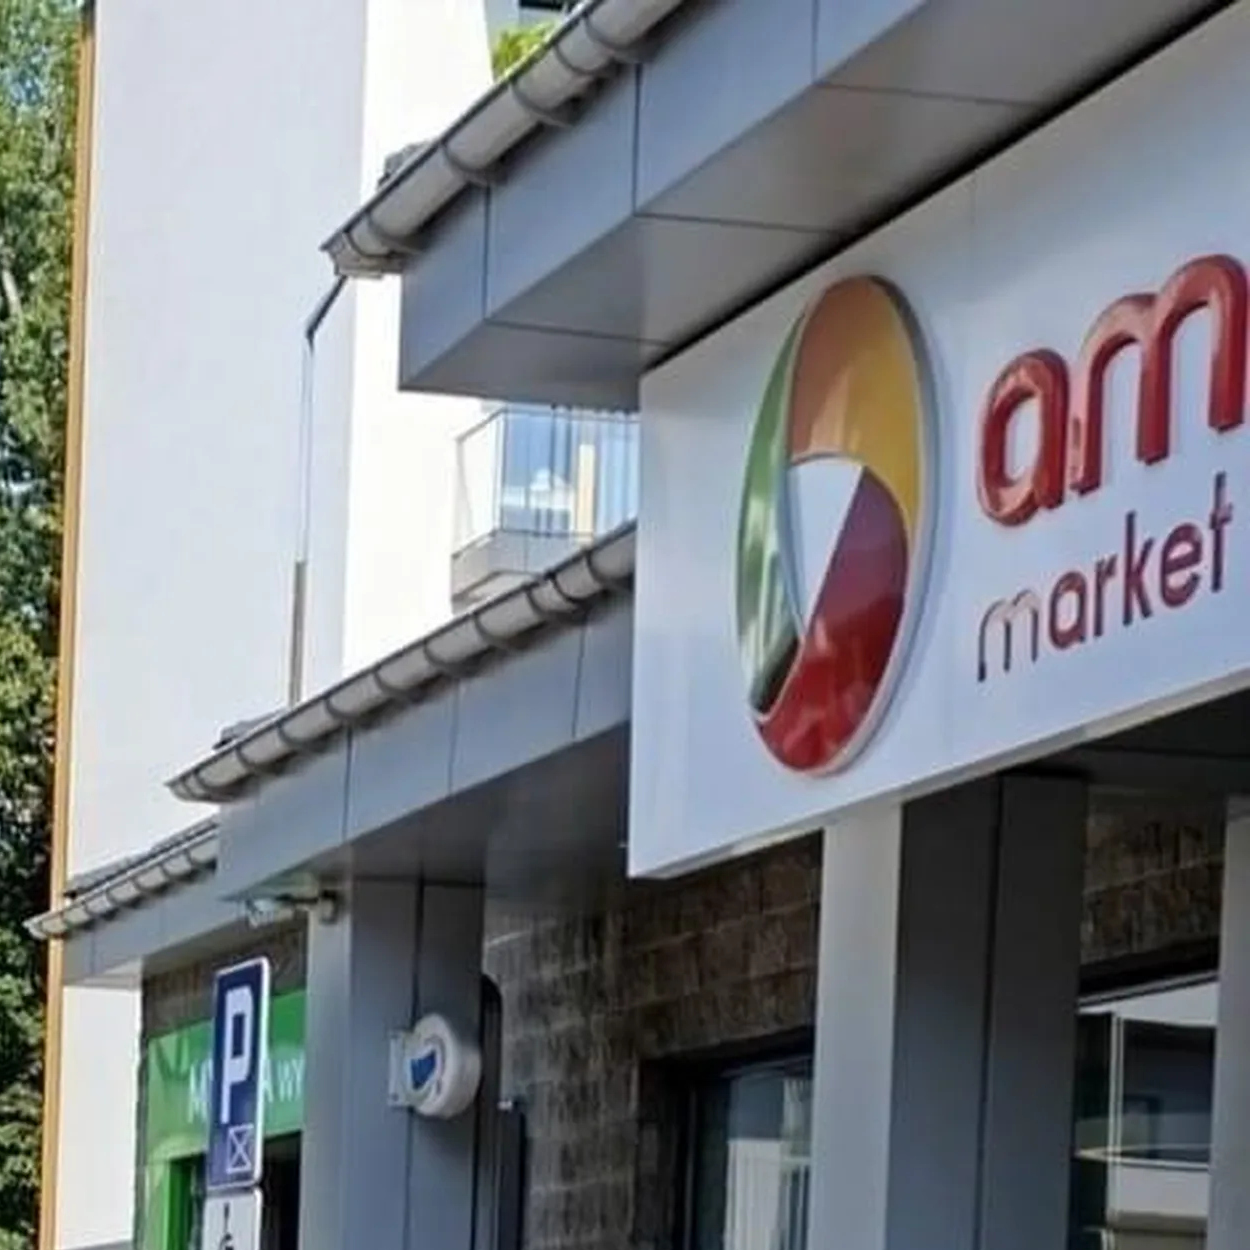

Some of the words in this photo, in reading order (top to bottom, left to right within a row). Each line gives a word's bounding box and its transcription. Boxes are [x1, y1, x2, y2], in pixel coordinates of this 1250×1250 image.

[977, 253, 1249, 527] am
[976, 470, 1234, 683] market
[221, 986, 253, 1124] P
